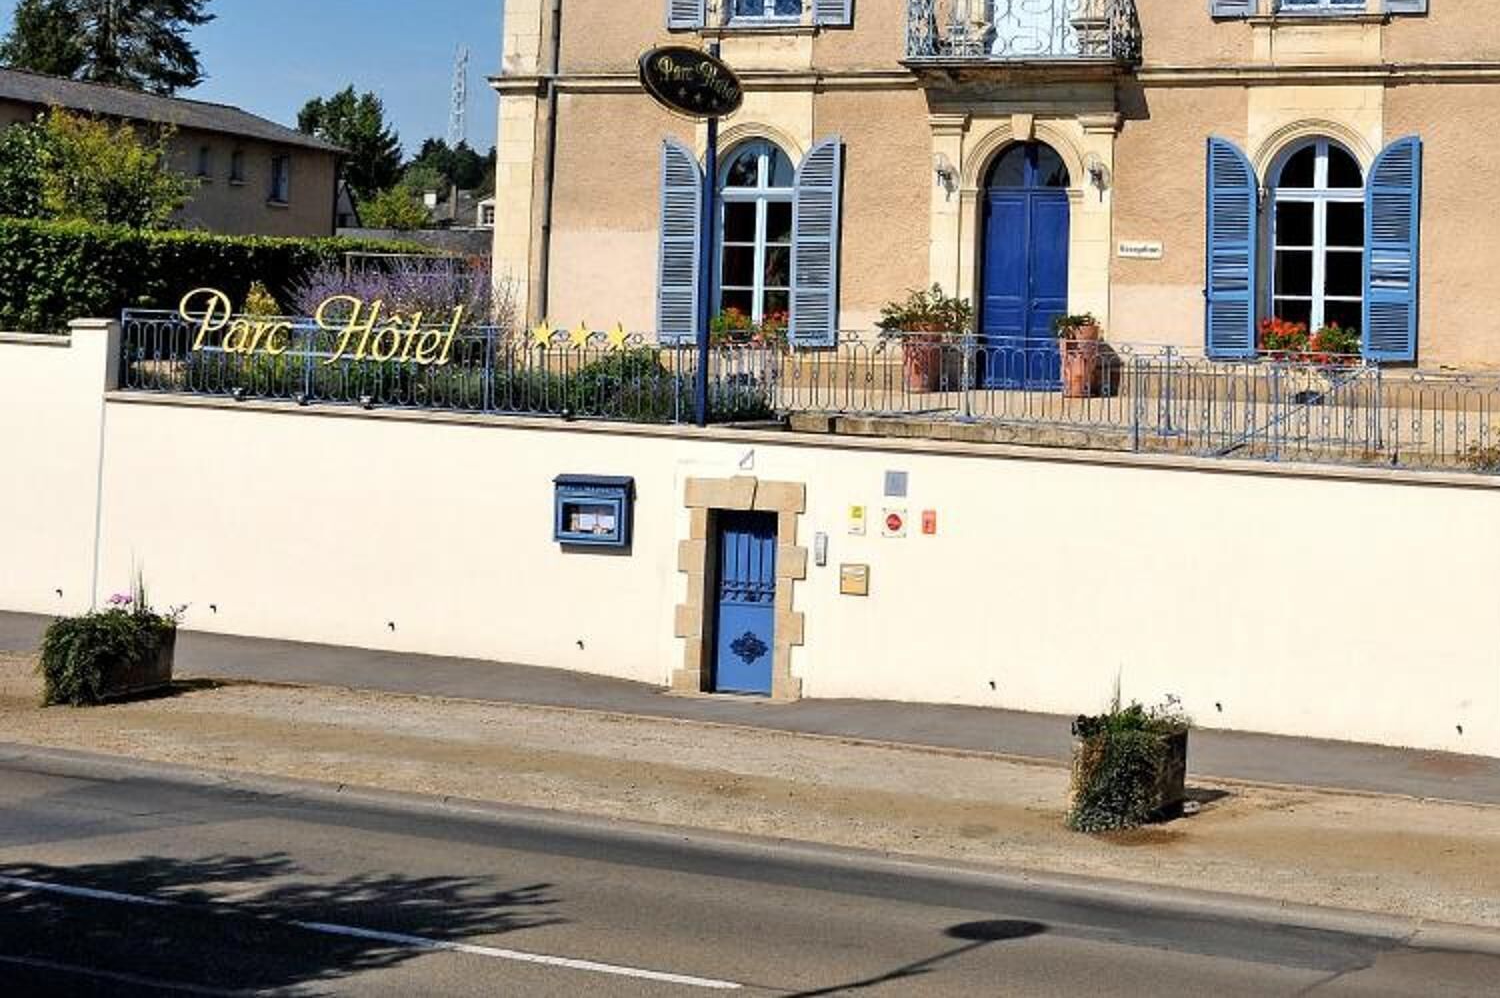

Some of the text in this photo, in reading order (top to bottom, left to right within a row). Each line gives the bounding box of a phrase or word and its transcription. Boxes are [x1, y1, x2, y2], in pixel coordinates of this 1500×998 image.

[657, 55, 694, 82] Parc
[179, 287, 464, 365] Parc Hôtel
